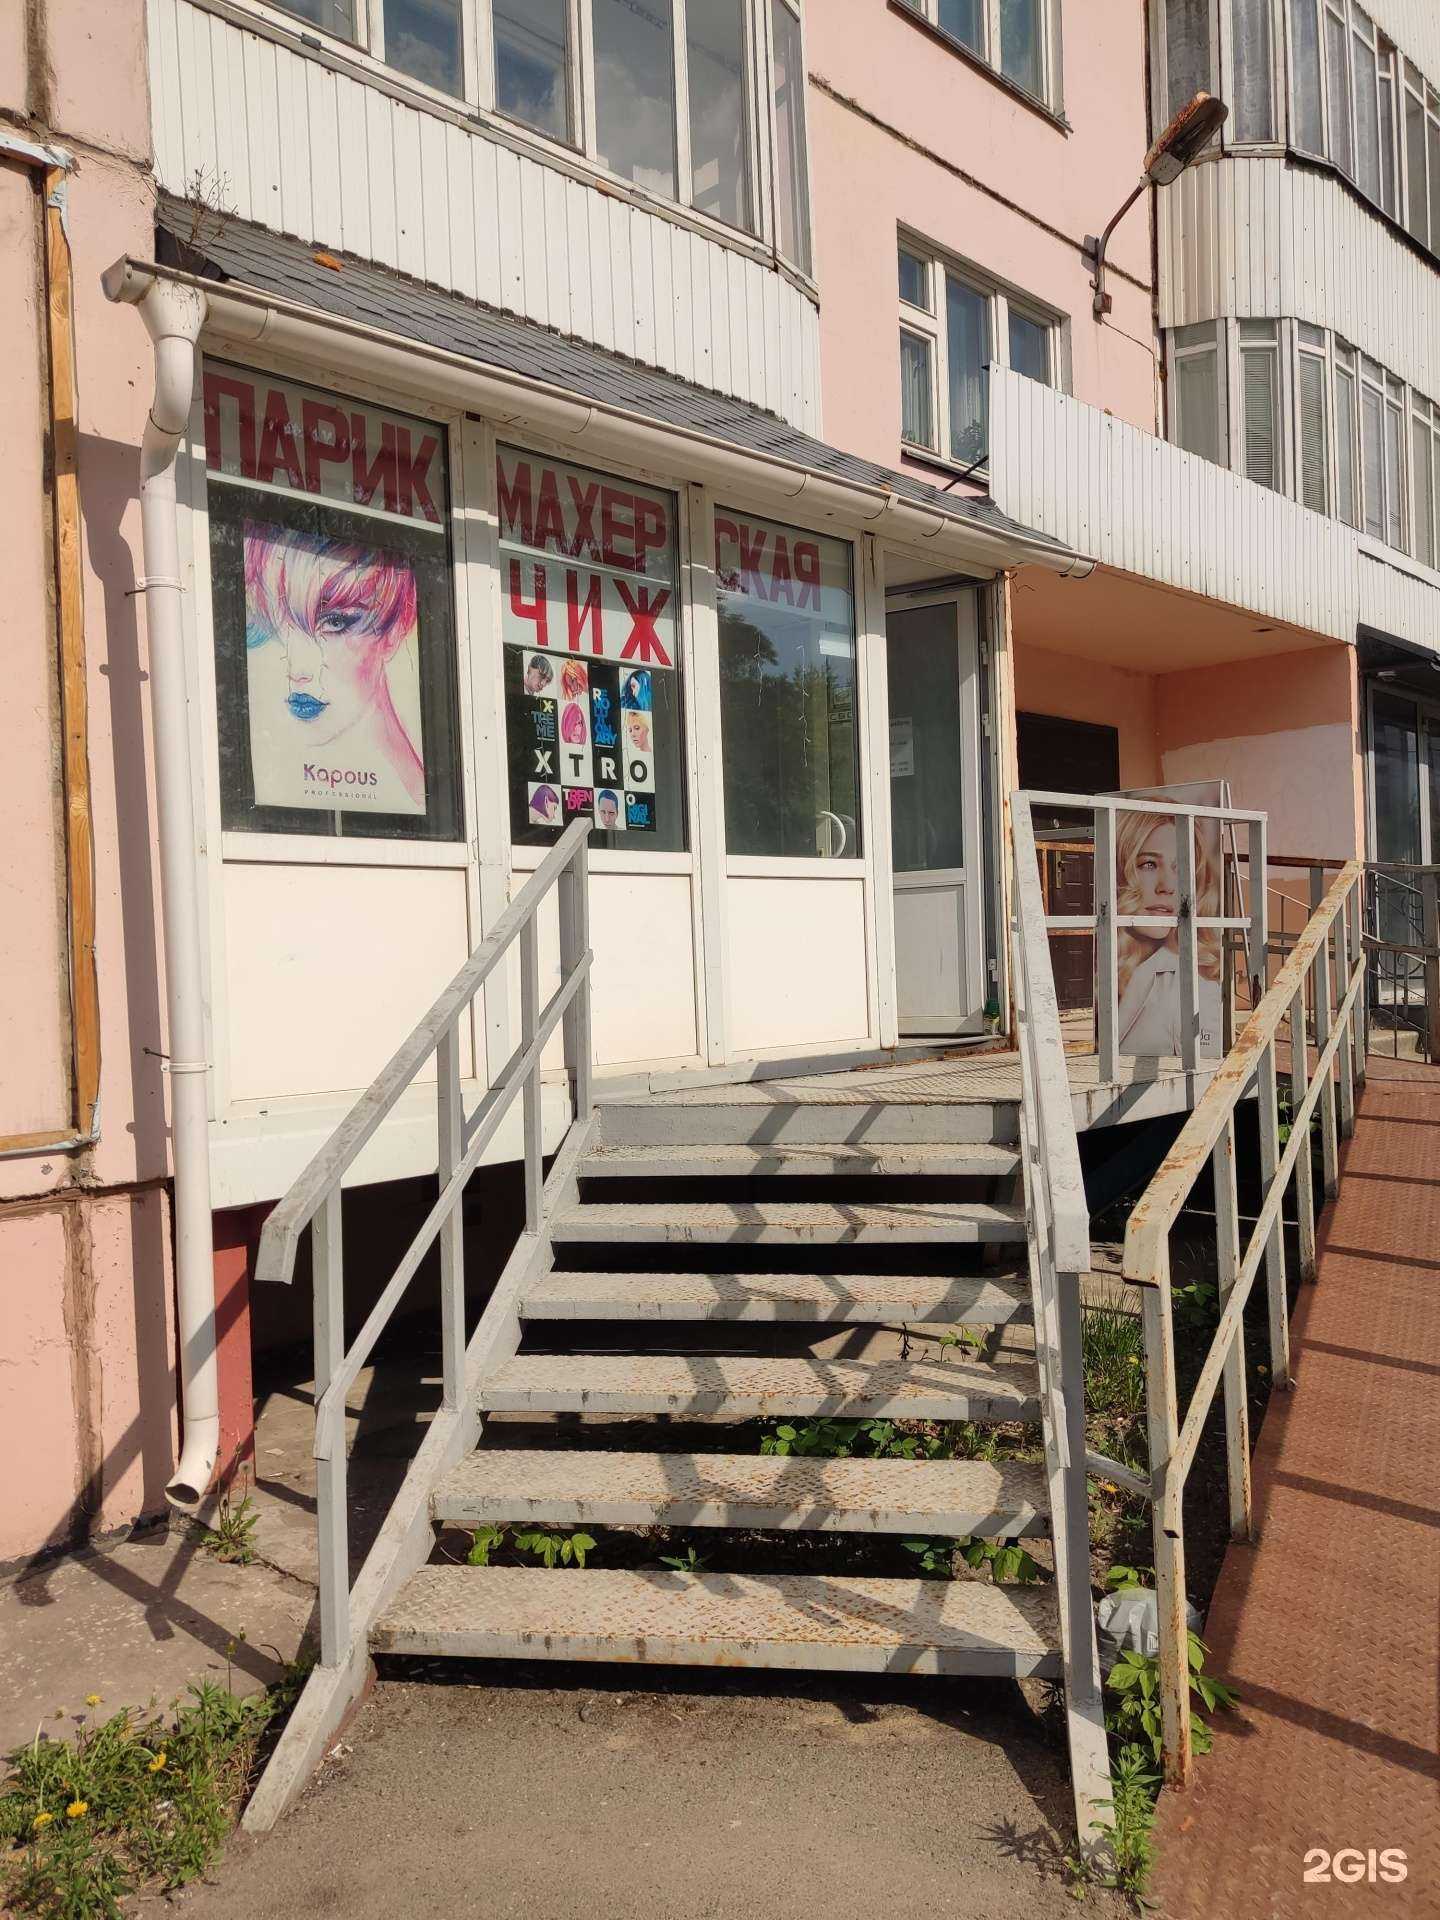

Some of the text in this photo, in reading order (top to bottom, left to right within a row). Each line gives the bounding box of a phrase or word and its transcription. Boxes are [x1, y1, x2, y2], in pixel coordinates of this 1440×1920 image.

[202, 371, 822, 612] ПАРИК МАХЕР СКАЯ
[509, 558, 673, 667] ЧИЖ
[304, 763, 378, 788] Kapous
